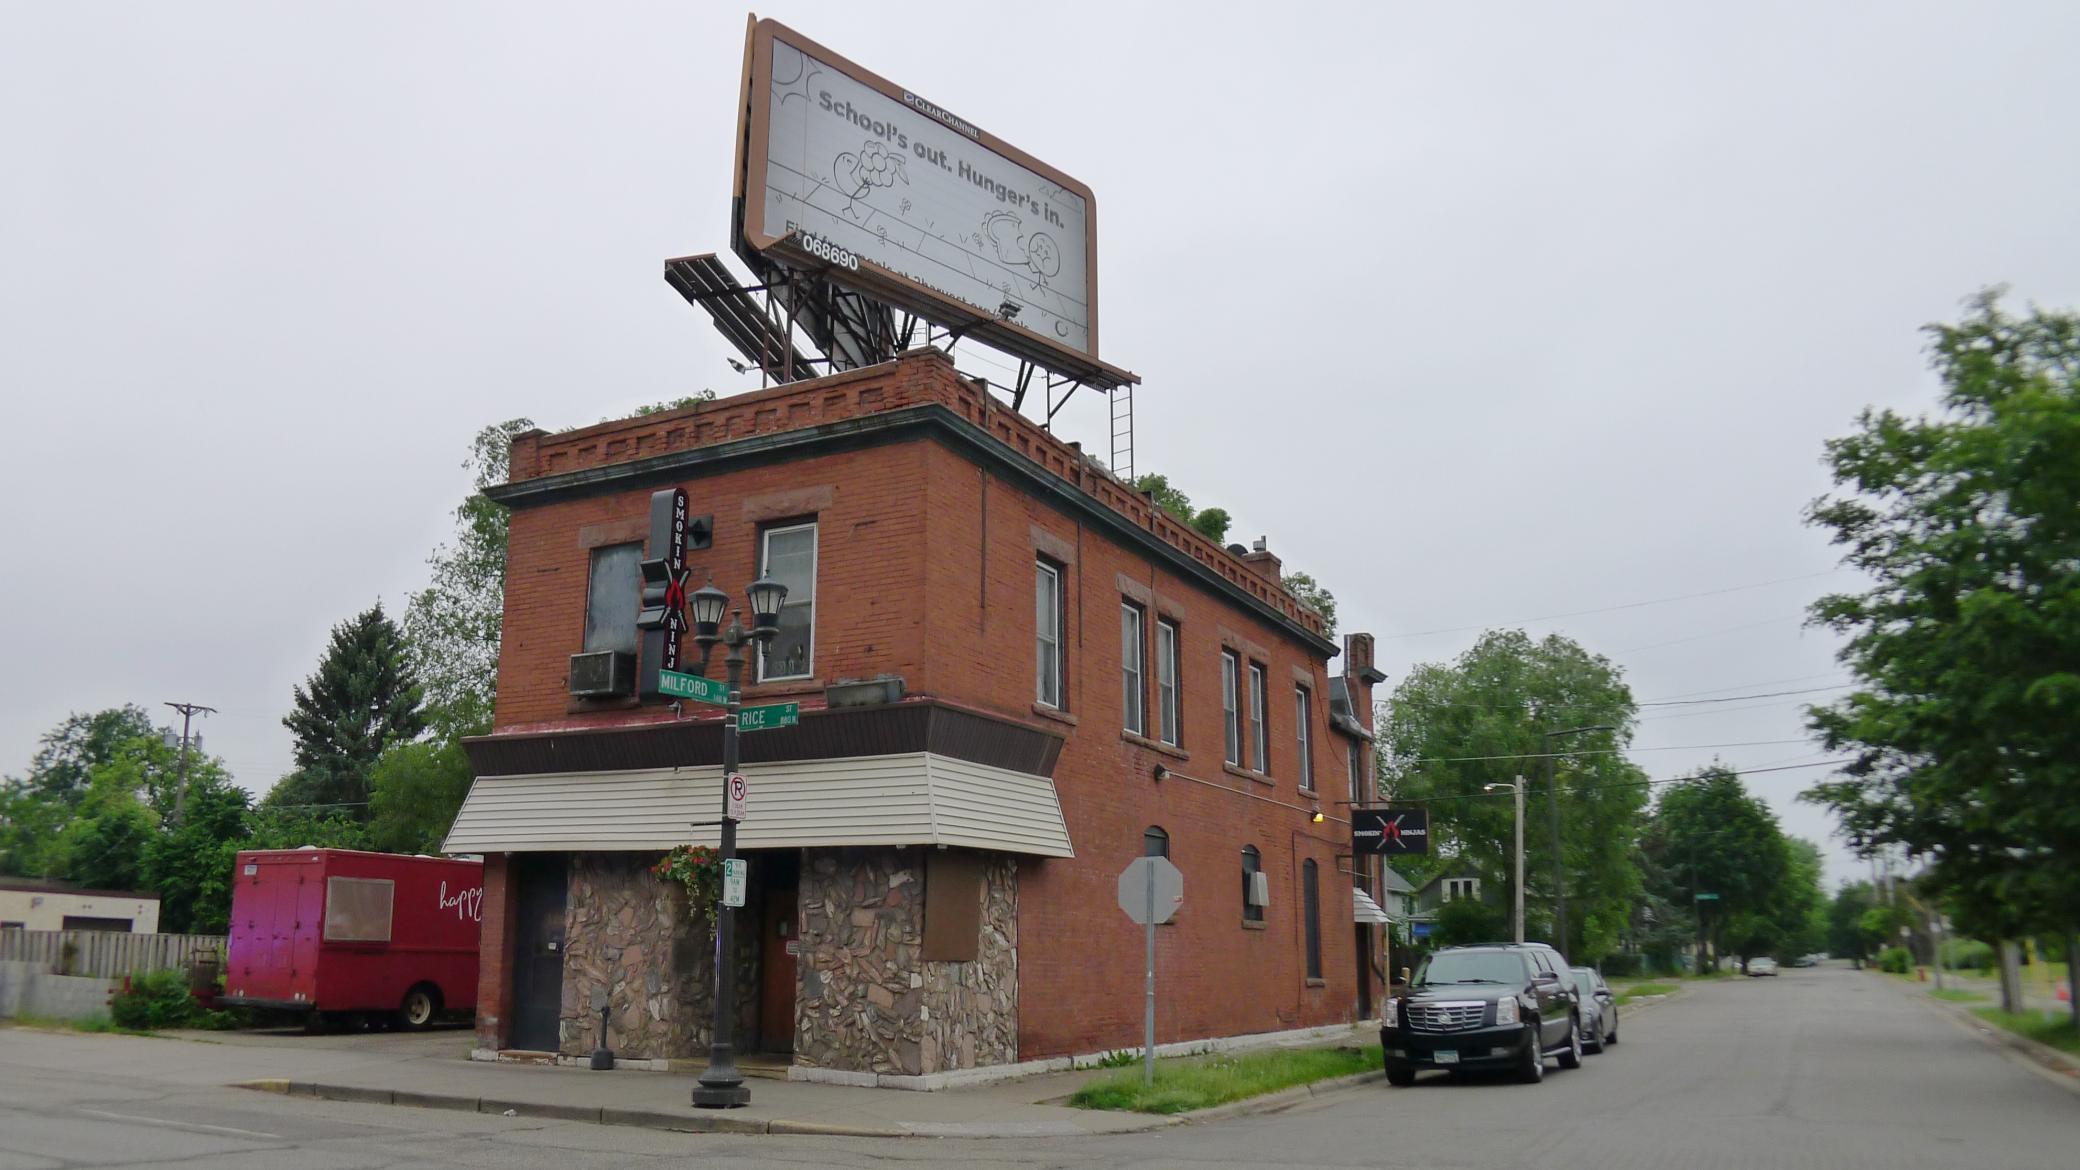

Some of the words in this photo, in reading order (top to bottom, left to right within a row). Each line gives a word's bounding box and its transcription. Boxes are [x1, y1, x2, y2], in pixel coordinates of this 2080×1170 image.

[819, 90, 908, 150] School's
[913, 142, 952, 173] out.
[958, 160, 1040, 216] Hunger's
[1044, 202, 1065, 229] in.
[803, 235, 859, 271] 068690
[667, 617, 678, 669] NINJ
[661, 674, 708, 697] MILFORD
[742, 710, 766, 726] RICE
[440, 880, 483, 922] happy
